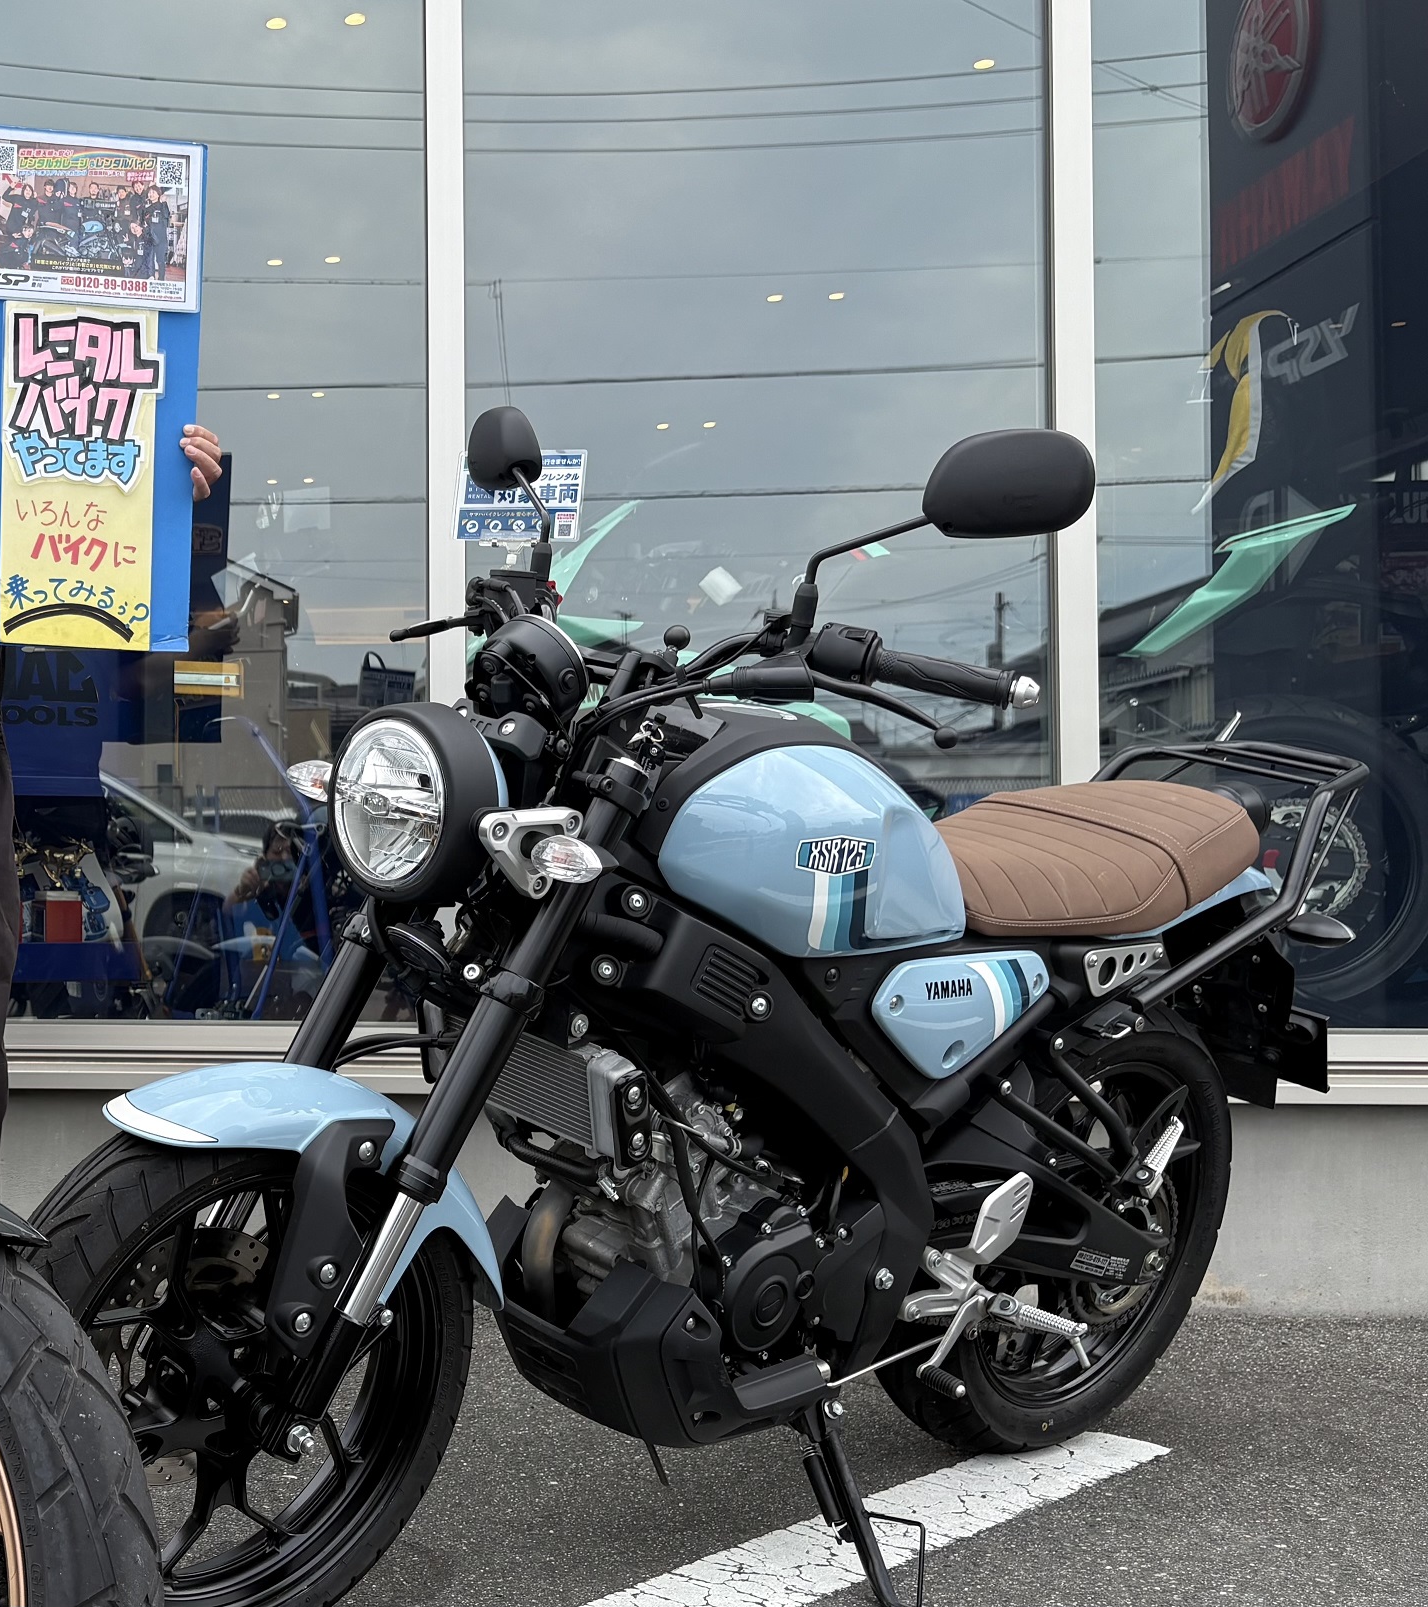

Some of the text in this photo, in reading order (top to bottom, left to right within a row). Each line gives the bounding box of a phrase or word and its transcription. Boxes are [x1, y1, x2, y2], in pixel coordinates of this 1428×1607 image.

[75, 276, 148, 293] 0120-89-0388
[14, 314, 158, 387] レンタル
[9, 376, 135, 441] バイク
[10, 431, 140, 487] やってます
[15, 499, 108, 531] いろんな
[30, 533, 137, 572] バイクに
[2, 705, 99, 727] OOLS
[808, 838, 867, 873] XSR125
[925, 978, 973, 1001] YAMAHA
